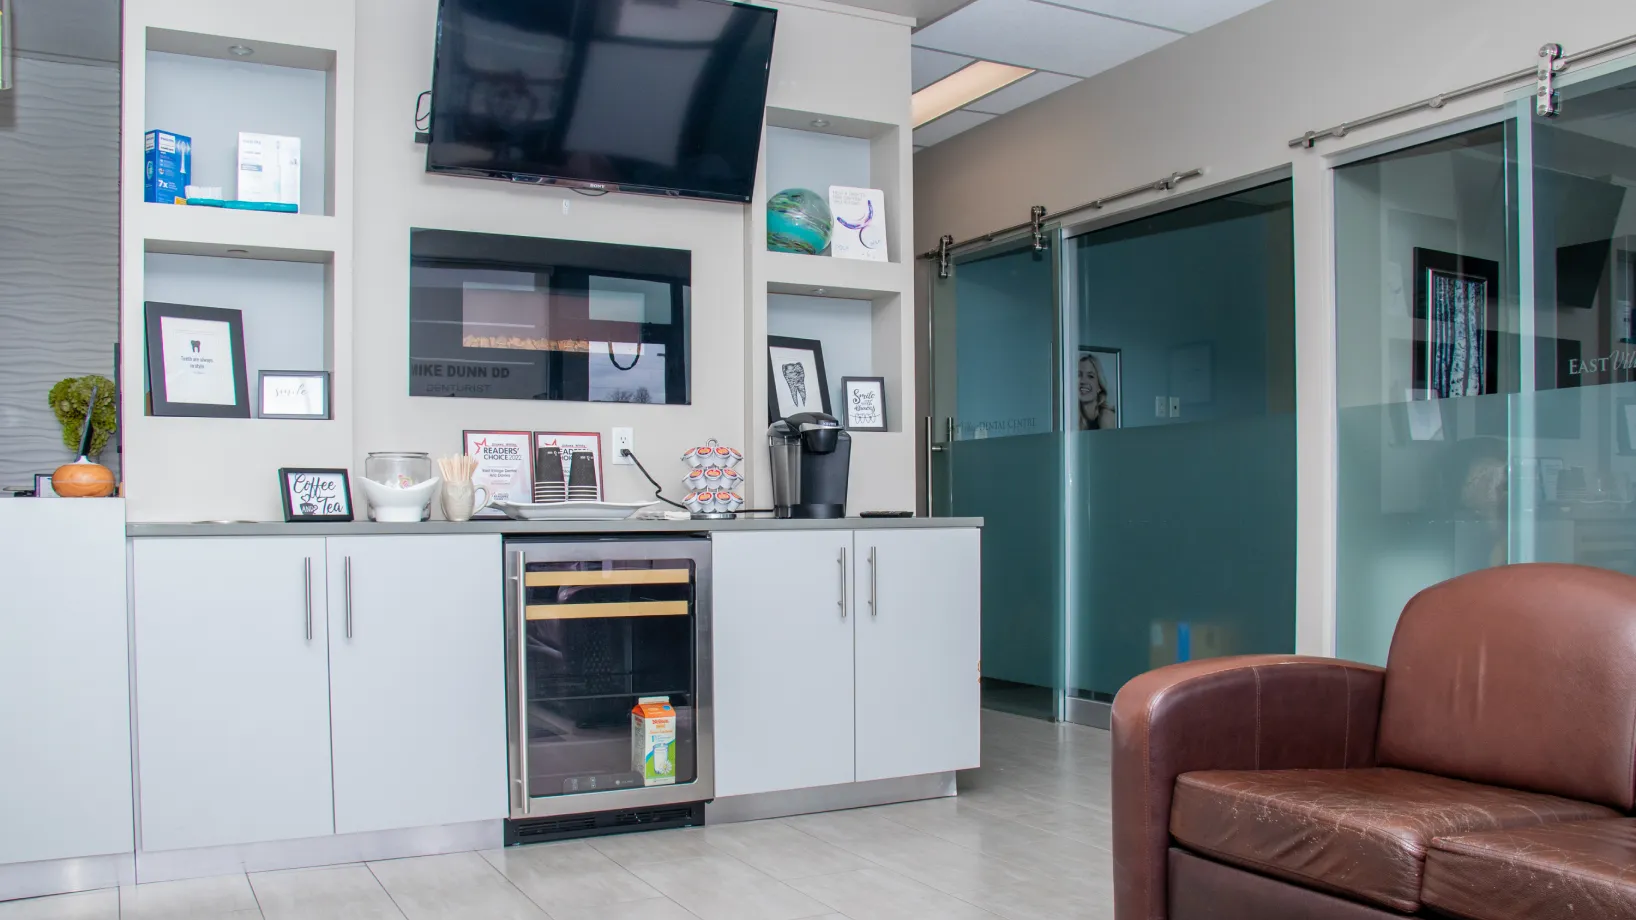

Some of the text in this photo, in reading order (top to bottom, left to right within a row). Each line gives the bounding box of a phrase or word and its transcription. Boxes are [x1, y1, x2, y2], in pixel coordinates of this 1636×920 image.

[447, 365, 487, 378] DUNN
[492, 367, 510, 378] DD
[1568, 357, 1609, 375] EAST
[426, 384, 492, 393] DENTURIST
[853, 389, 875, 404] Smile
[979, 420, 1006, 430] DENTAL
[1007, 418, 1037, 429] CENTRE
[294, 473, 336, 498] Coffee
[302, 495, 343, 515] AND Tea
